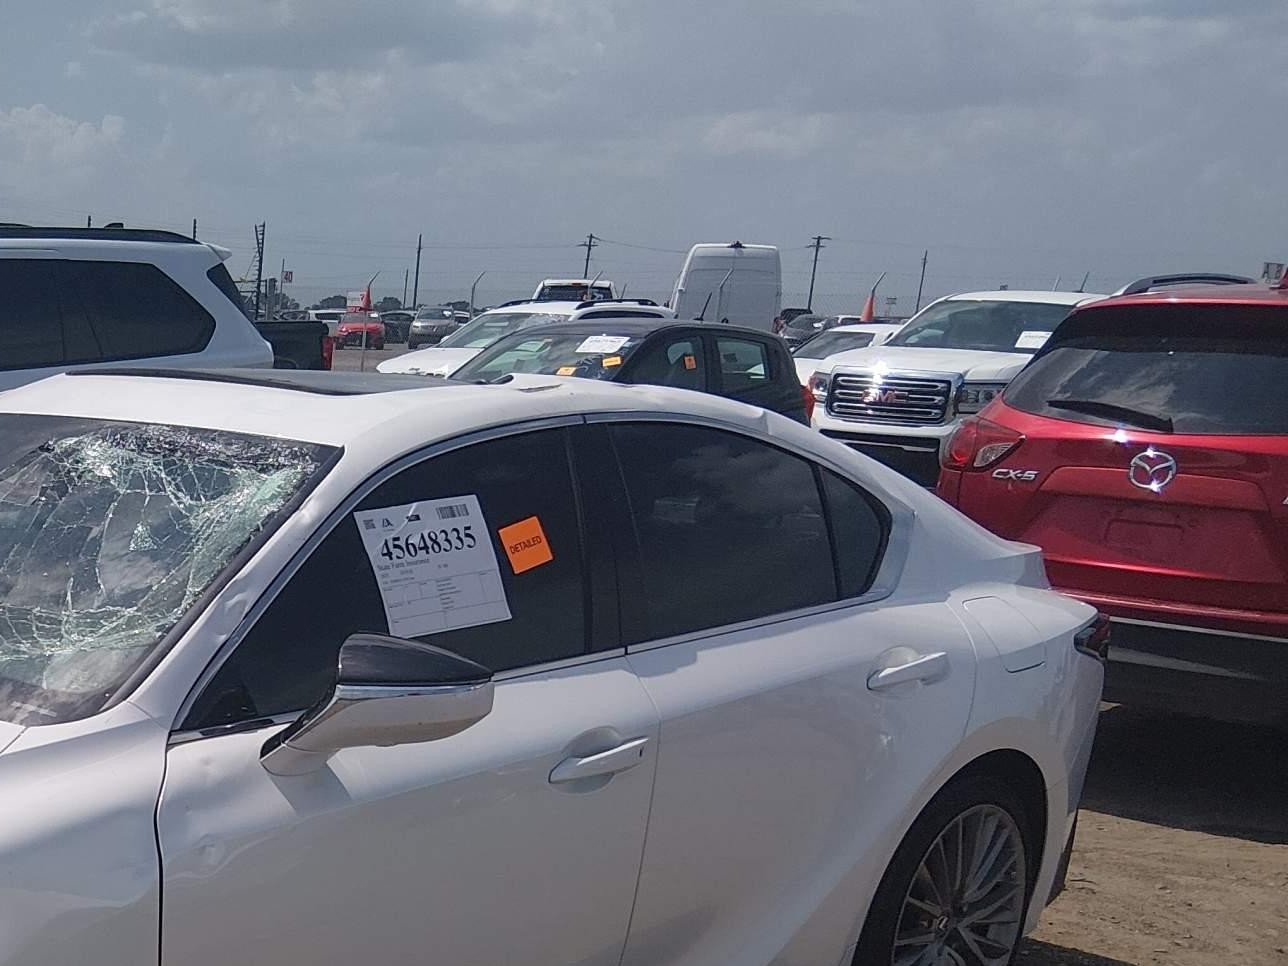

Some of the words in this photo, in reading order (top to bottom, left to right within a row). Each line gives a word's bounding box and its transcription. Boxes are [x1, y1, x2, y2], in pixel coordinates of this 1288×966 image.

[991, 468, 1040, 481] CX-5
[380, 525, 477, 561] 45648335
[509, 535, 543, 555] DETAILED
